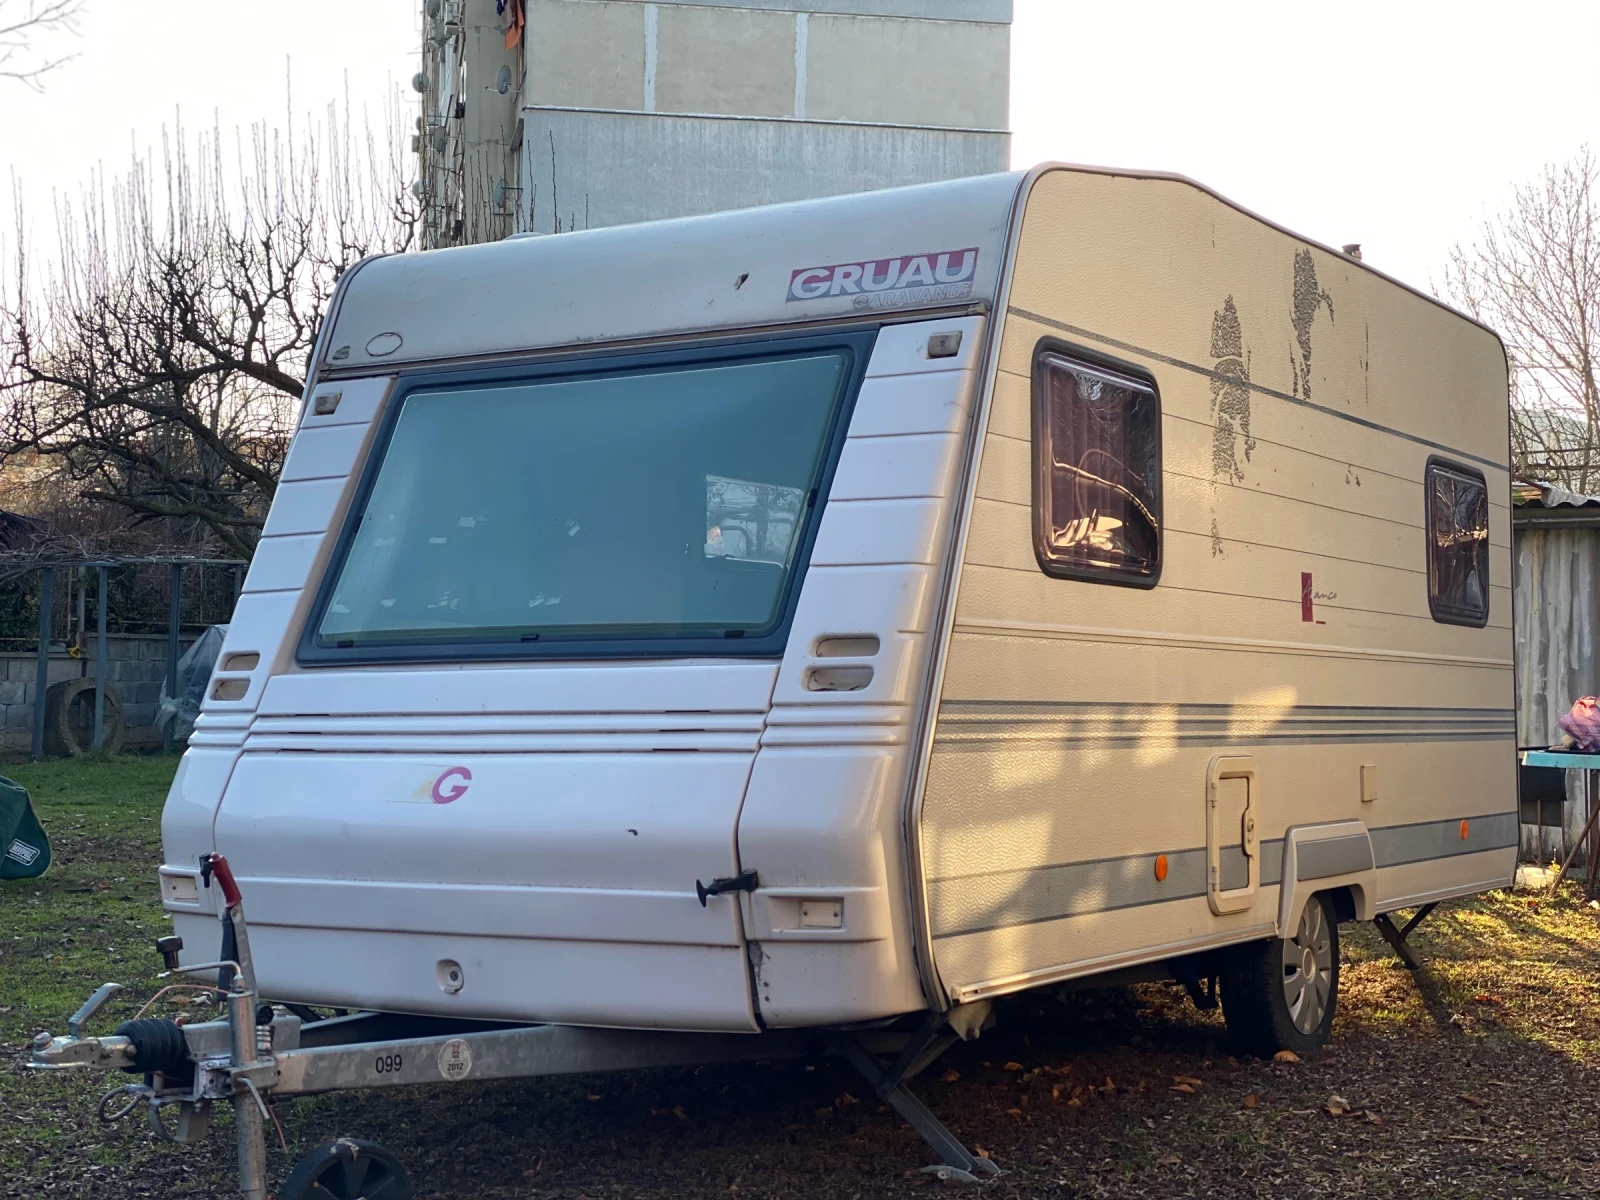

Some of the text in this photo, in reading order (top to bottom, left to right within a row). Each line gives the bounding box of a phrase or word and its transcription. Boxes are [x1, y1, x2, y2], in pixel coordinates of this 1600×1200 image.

[791, 251, 976, 299] GRUAU
[853, 283, 970, 310] CARAVANES
[431, 766, 472, 805] G
[375, 1054, 403, 1074] 099
[447, 1062, 464, 1072] 2012
